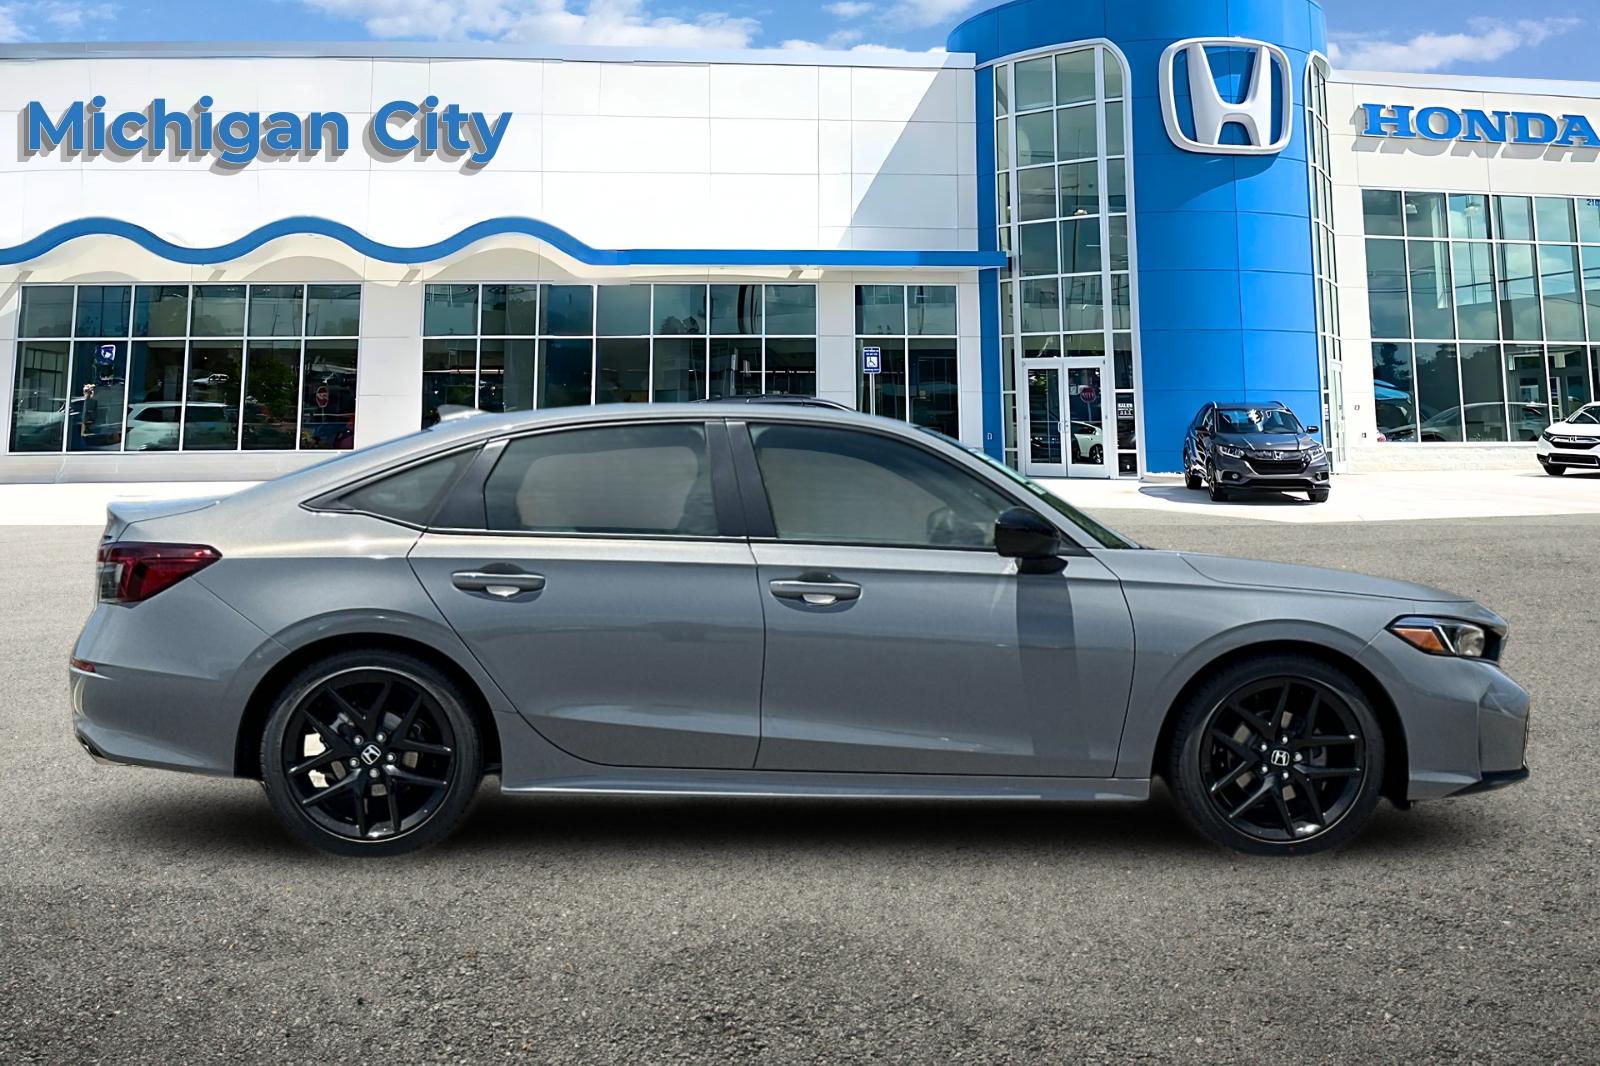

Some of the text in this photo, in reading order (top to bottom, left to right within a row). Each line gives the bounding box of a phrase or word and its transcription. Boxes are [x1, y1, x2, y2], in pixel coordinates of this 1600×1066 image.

[28, 95, 513, 164] Michigan City
[1361, 103, 1600, 148] HONDA
